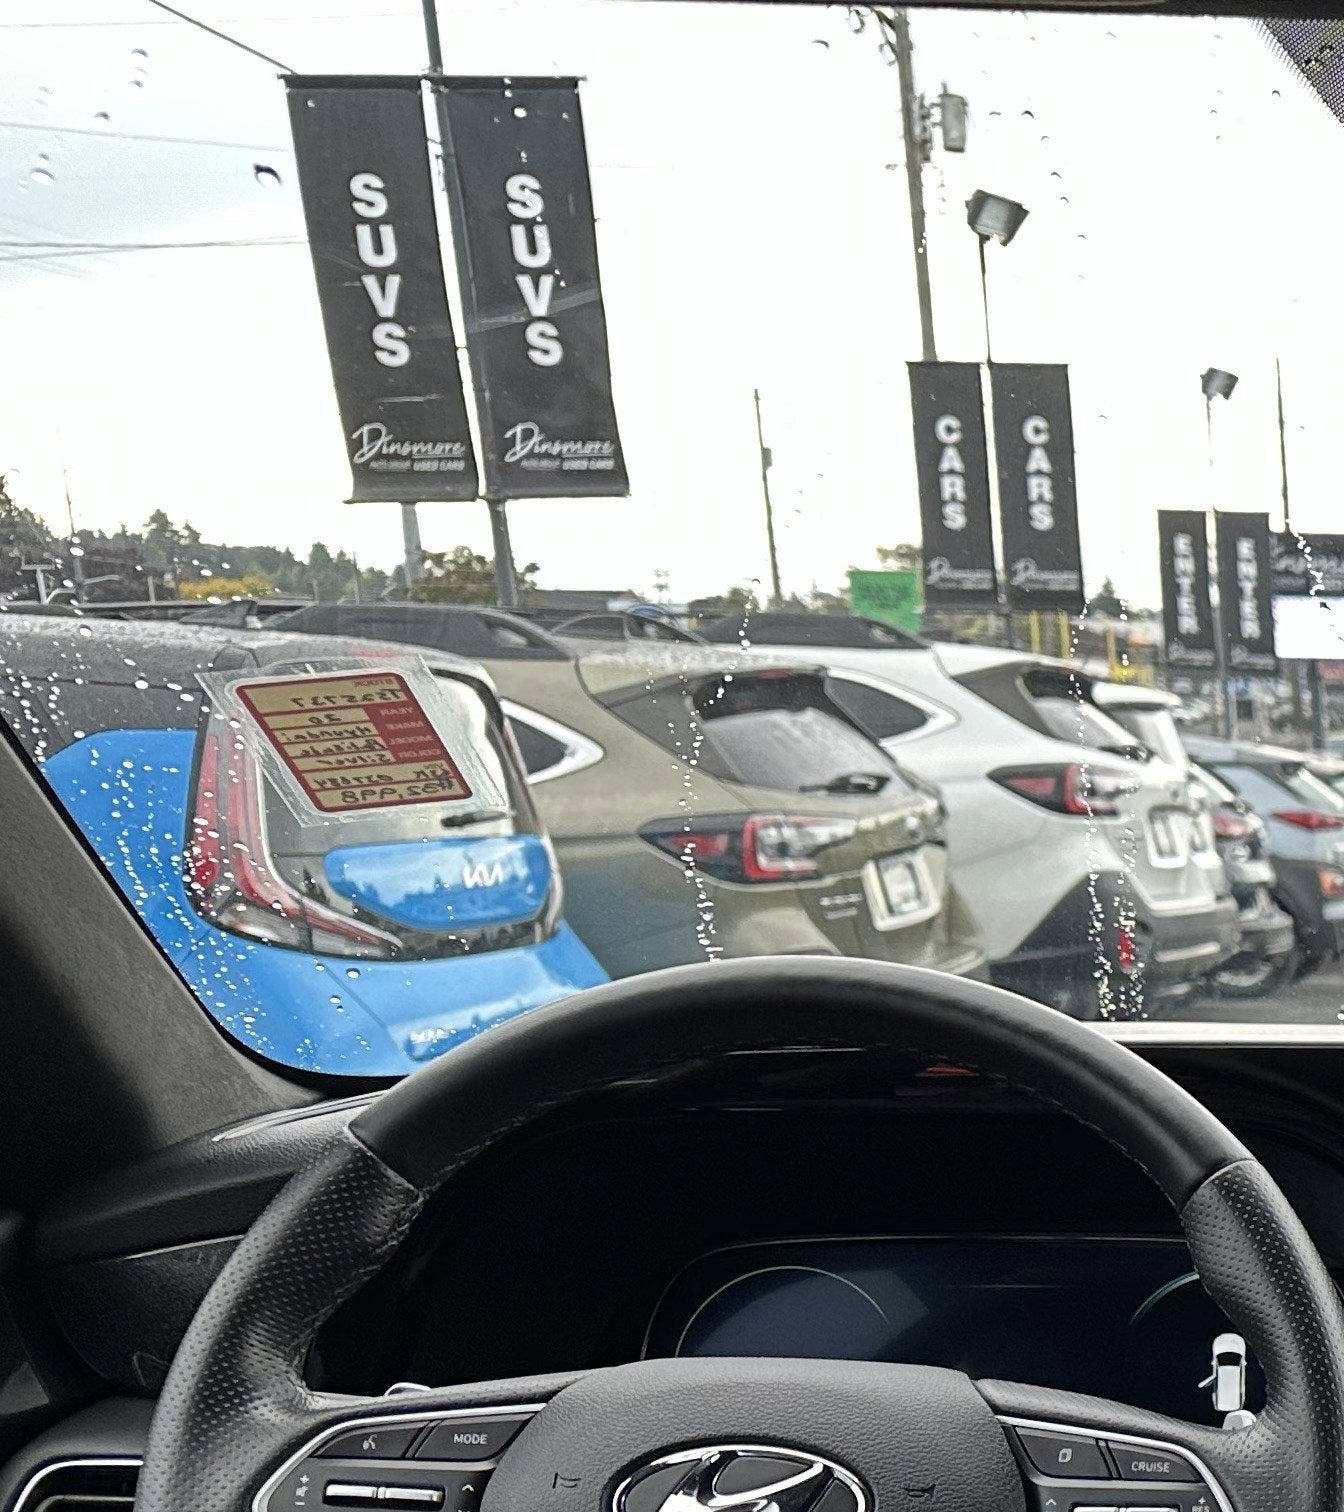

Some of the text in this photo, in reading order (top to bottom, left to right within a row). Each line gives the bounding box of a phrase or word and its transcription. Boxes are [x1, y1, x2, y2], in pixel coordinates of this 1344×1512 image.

[349, 172, 412, 368] SUVS
[504, 173, 564, 368] SUVS
[934, 414, 967, 532] CARS
[1021, 414, 1055, 532] CARS
[453, 1432, 488, 1446] MODE
[1130, 1460, 1171, 1474] CRUISE
